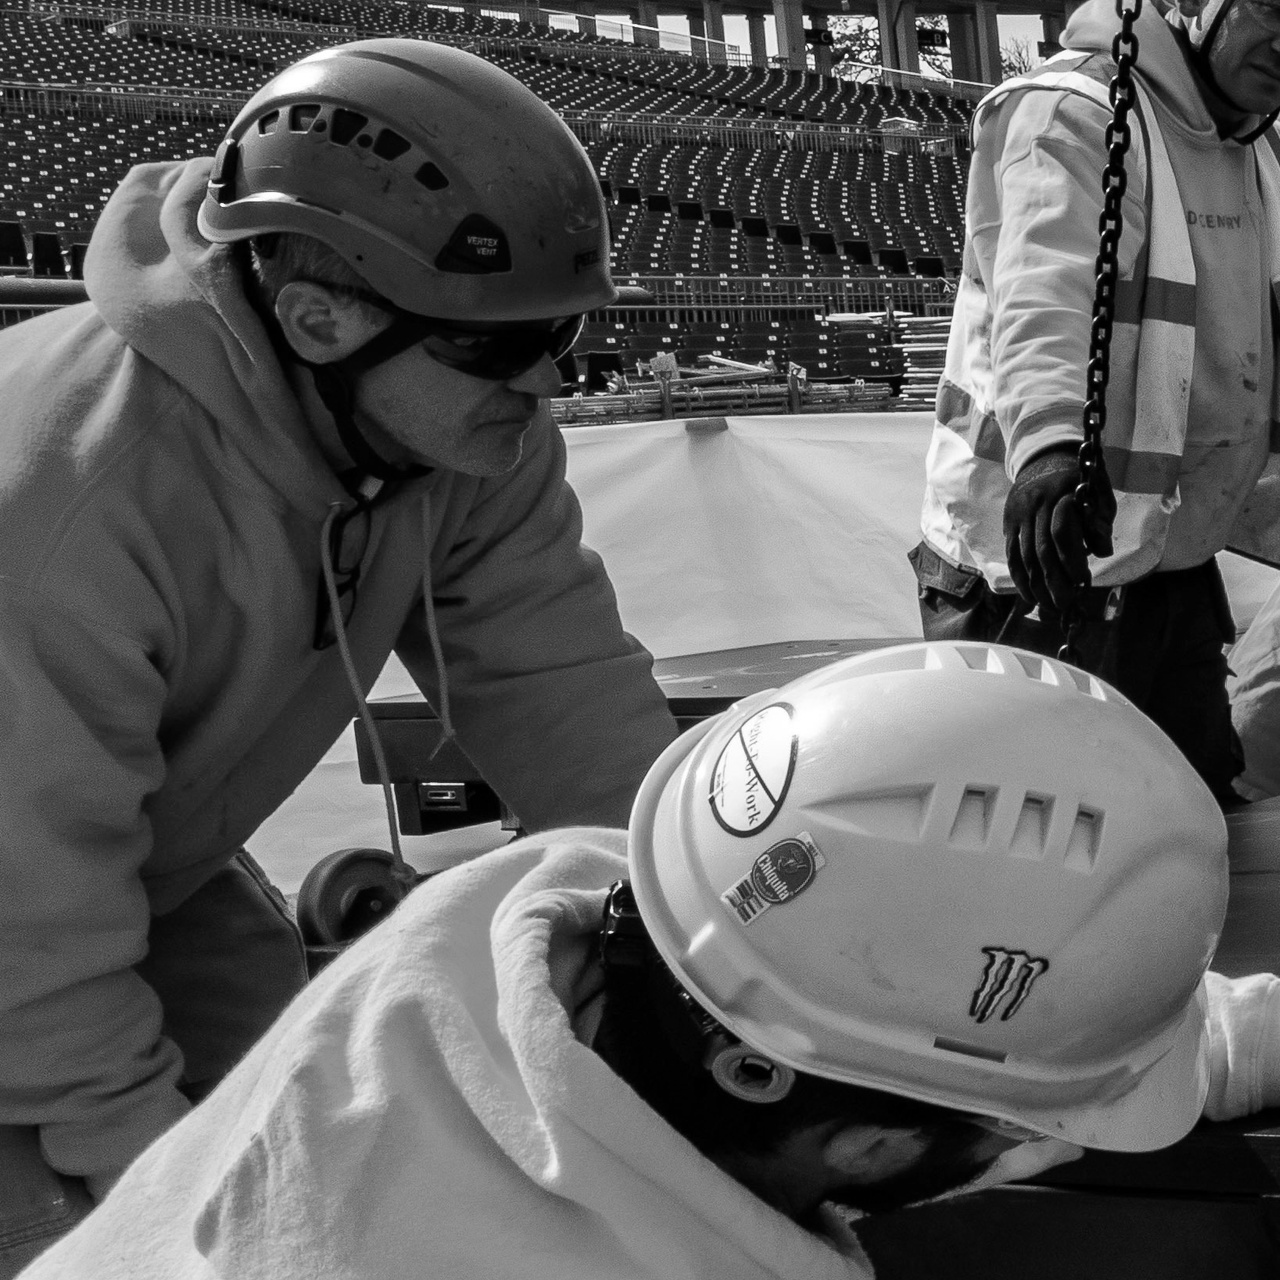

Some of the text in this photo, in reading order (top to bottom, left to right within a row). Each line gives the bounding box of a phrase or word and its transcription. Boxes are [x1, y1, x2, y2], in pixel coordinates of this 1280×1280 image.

[820, 32, 831, 43] C
[933, 34, 943, 45] B
[467, 236, 498, 247] VERTEX
[476, 247, 497, 256] VENT
[757, 853, 790, 901] Chiquita
